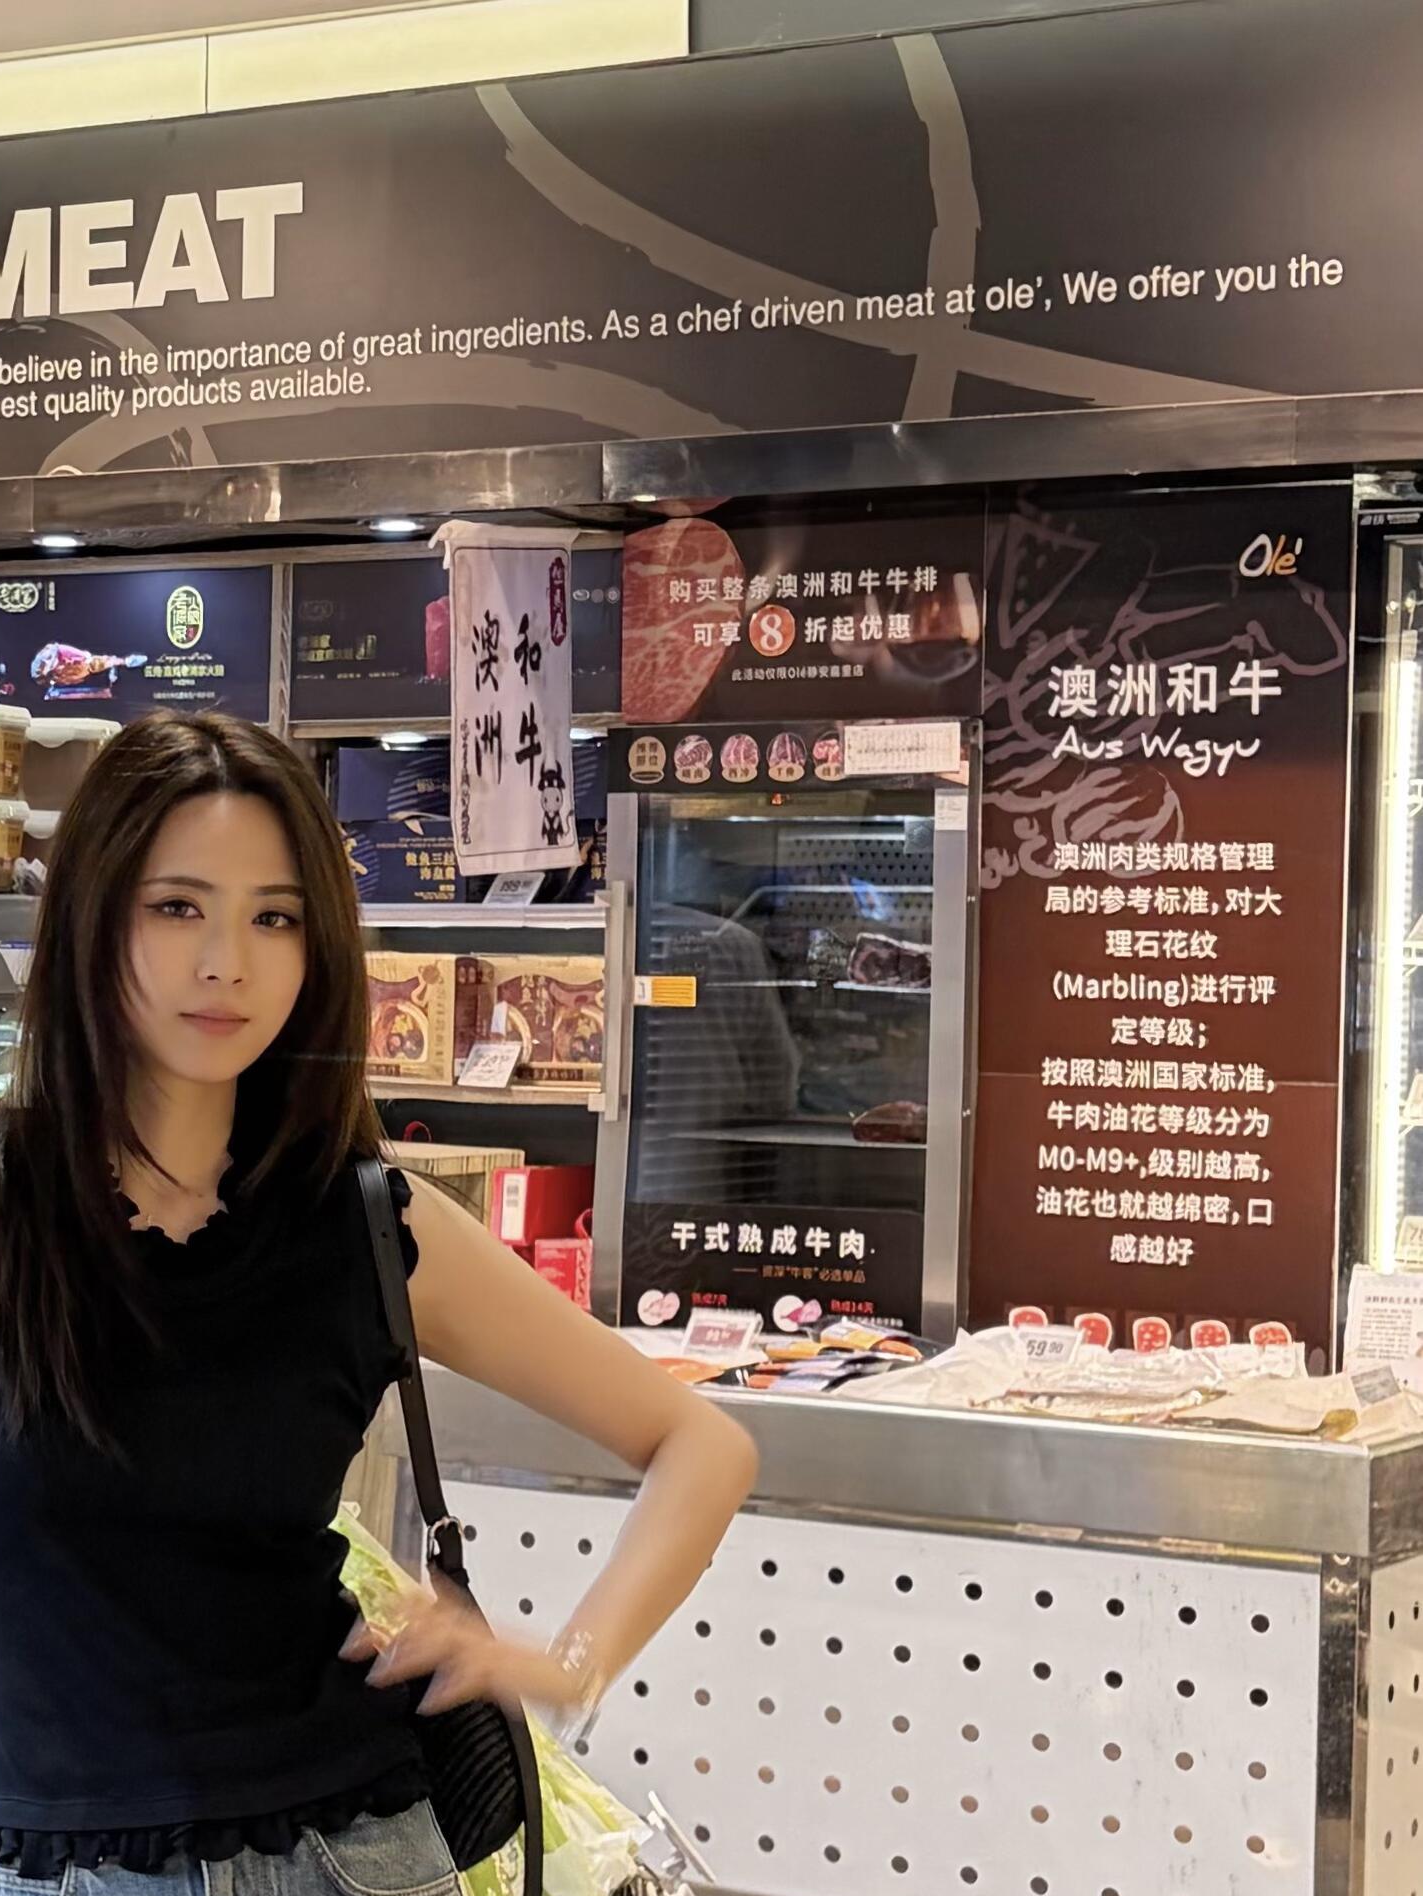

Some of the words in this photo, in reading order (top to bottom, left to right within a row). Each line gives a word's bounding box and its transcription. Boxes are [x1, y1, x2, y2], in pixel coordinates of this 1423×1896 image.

[89, 352, 113, 379] in
[118, 348, 158, 377] the
[165, 337, 313, 380] importance
[319, 333, 346, 361] of
[353, 328, 423, 367] great
[430, 313, 594, 361] ingredients.
[601, 309, 642, 341] As
[649, 313, 668, 337] a
[676, 300, 742, 335] chef
[751, 294, 846, 330] driven
[855, 286, 936, 321] meat
[945, 284, 976, 313] at
[1062, 271, 1118, 305] We
[1128, 263, 1206, 301] offer
[1213, 262, 1278, 300] you
[1286, 253, 1345, 290] the
[43, 382, 124, 423] quality
[131, 375, 243, 417] products
[248, 362, 373, 401] available.
[669, 565, 939, 604] 购买整条澳洲和牛牛排
[1047, 658, 1282, 718] 澳洲和牛
[1052, 726, 1124, 761] Aus
[1141, 727, 1261, 777] Wagyu
[1053, 841, 1276, 873] 澳洲肉类规格管理
[1105, 930, 1218, 961] 理石花纹
[1041, 1056, 1276, 1095] 按照澳洲国家标准，
[1046, 1101, 1271, 1138] 牛肉油花等级分为
[671, 1222, 866, 1259] 干式熟成牛肉
[1109, 1234, 1194, 1267] 感越好
